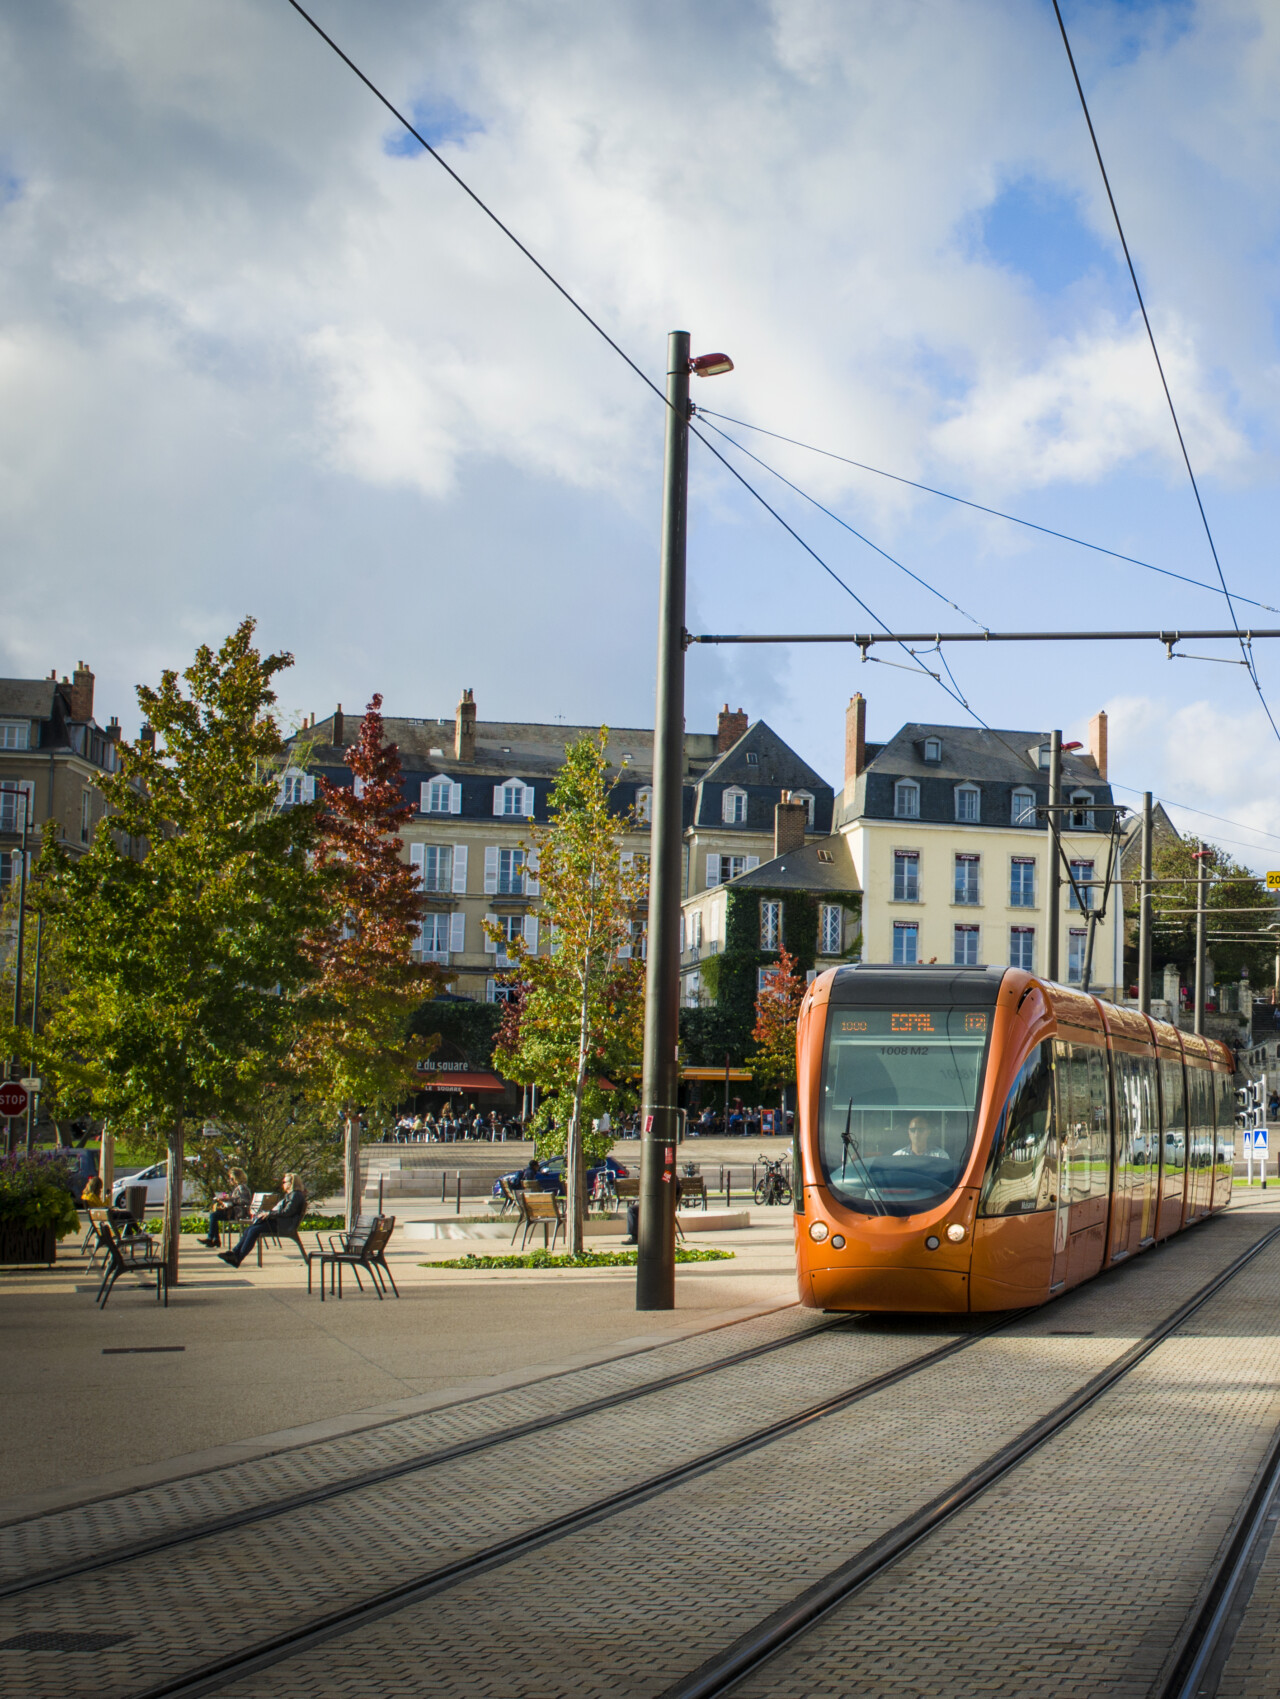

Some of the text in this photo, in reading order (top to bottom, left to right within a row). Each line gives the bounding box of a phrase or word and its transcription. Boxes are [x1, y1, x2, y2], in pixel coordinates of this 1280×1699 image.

[1269, 876, 1280, 884] 20
[891, 1013, 935, 1031] ESPAL
[881, 1046, 928, 1055] 1008 M2
[424, 1059, 435, 1070] du
[0, 1095, 25, 1105] STOP
